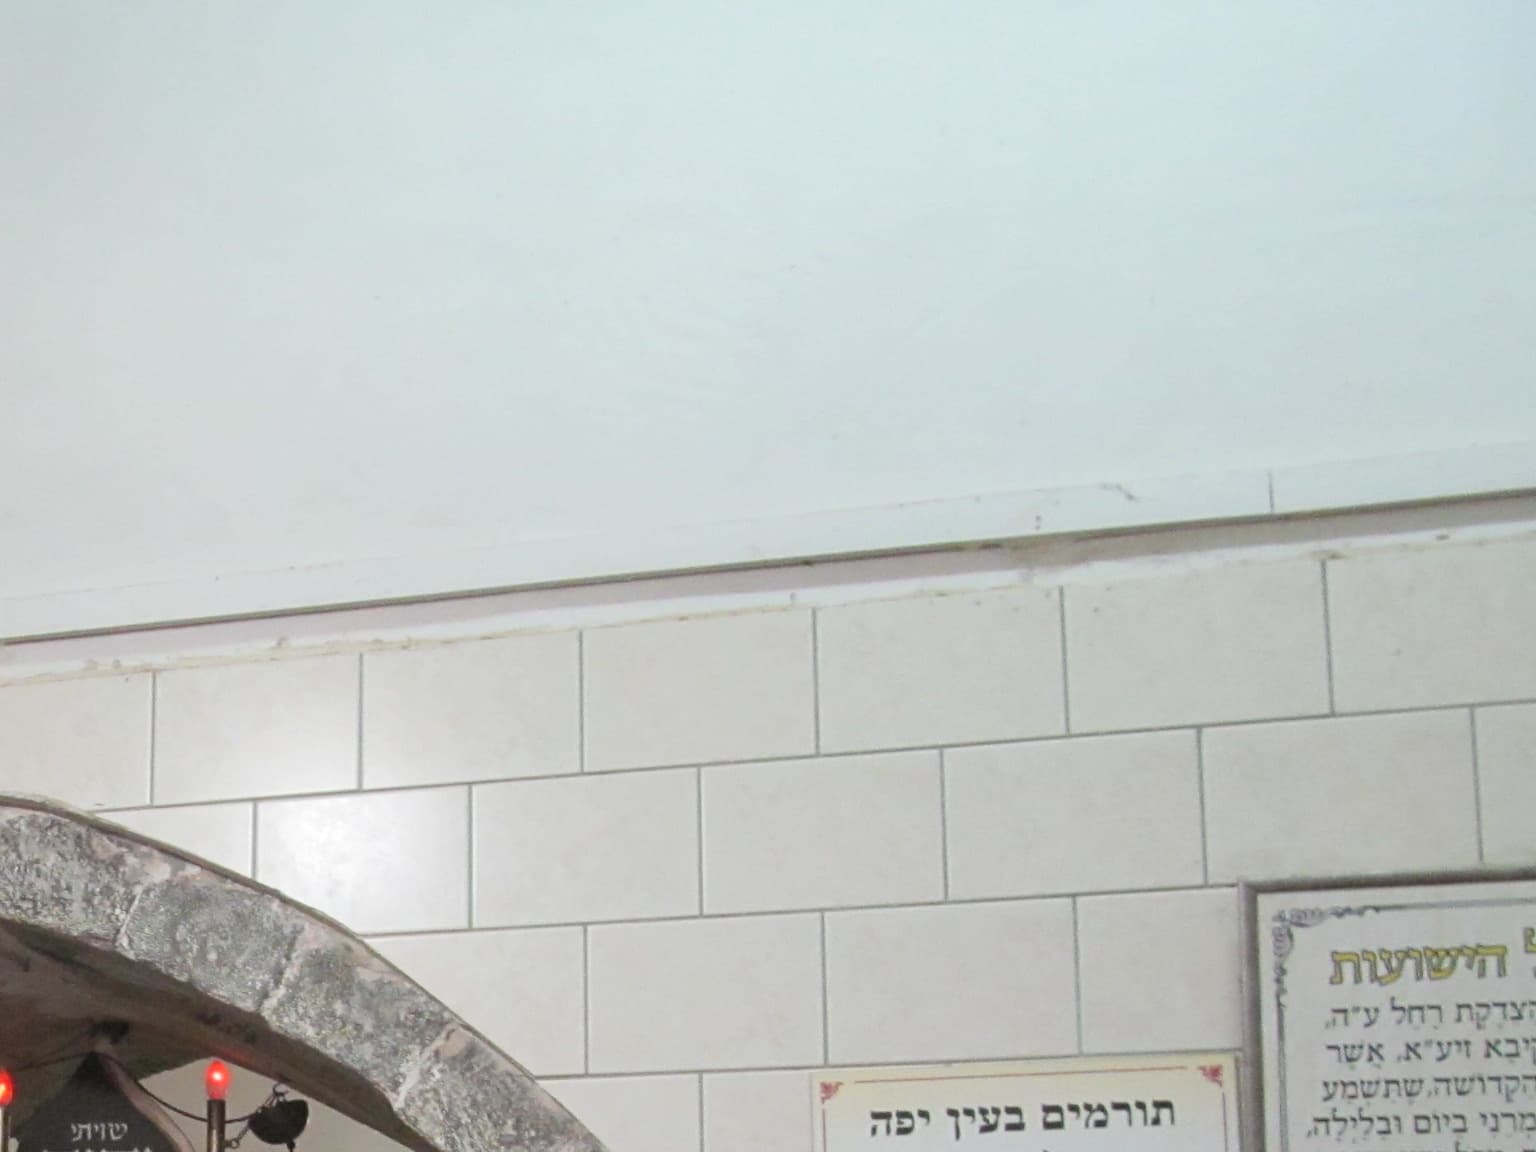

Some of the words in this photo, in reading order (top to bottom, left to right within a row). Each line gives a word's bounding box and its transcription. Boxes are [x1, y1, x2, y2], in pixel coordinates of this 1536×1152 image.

[1329, 943, 1508, 987] הישועות
[1390, 996, 1443, 1026] רחל
[870, 1109, 931, 1138] יפה
[947, 1104, 1026, 1140] בעין
[1041, 1098, 1176, 1131] תורמים
[1414, 1112, 1469, 1135] ביום
[70, 1121, 129, 1142] שויתי
